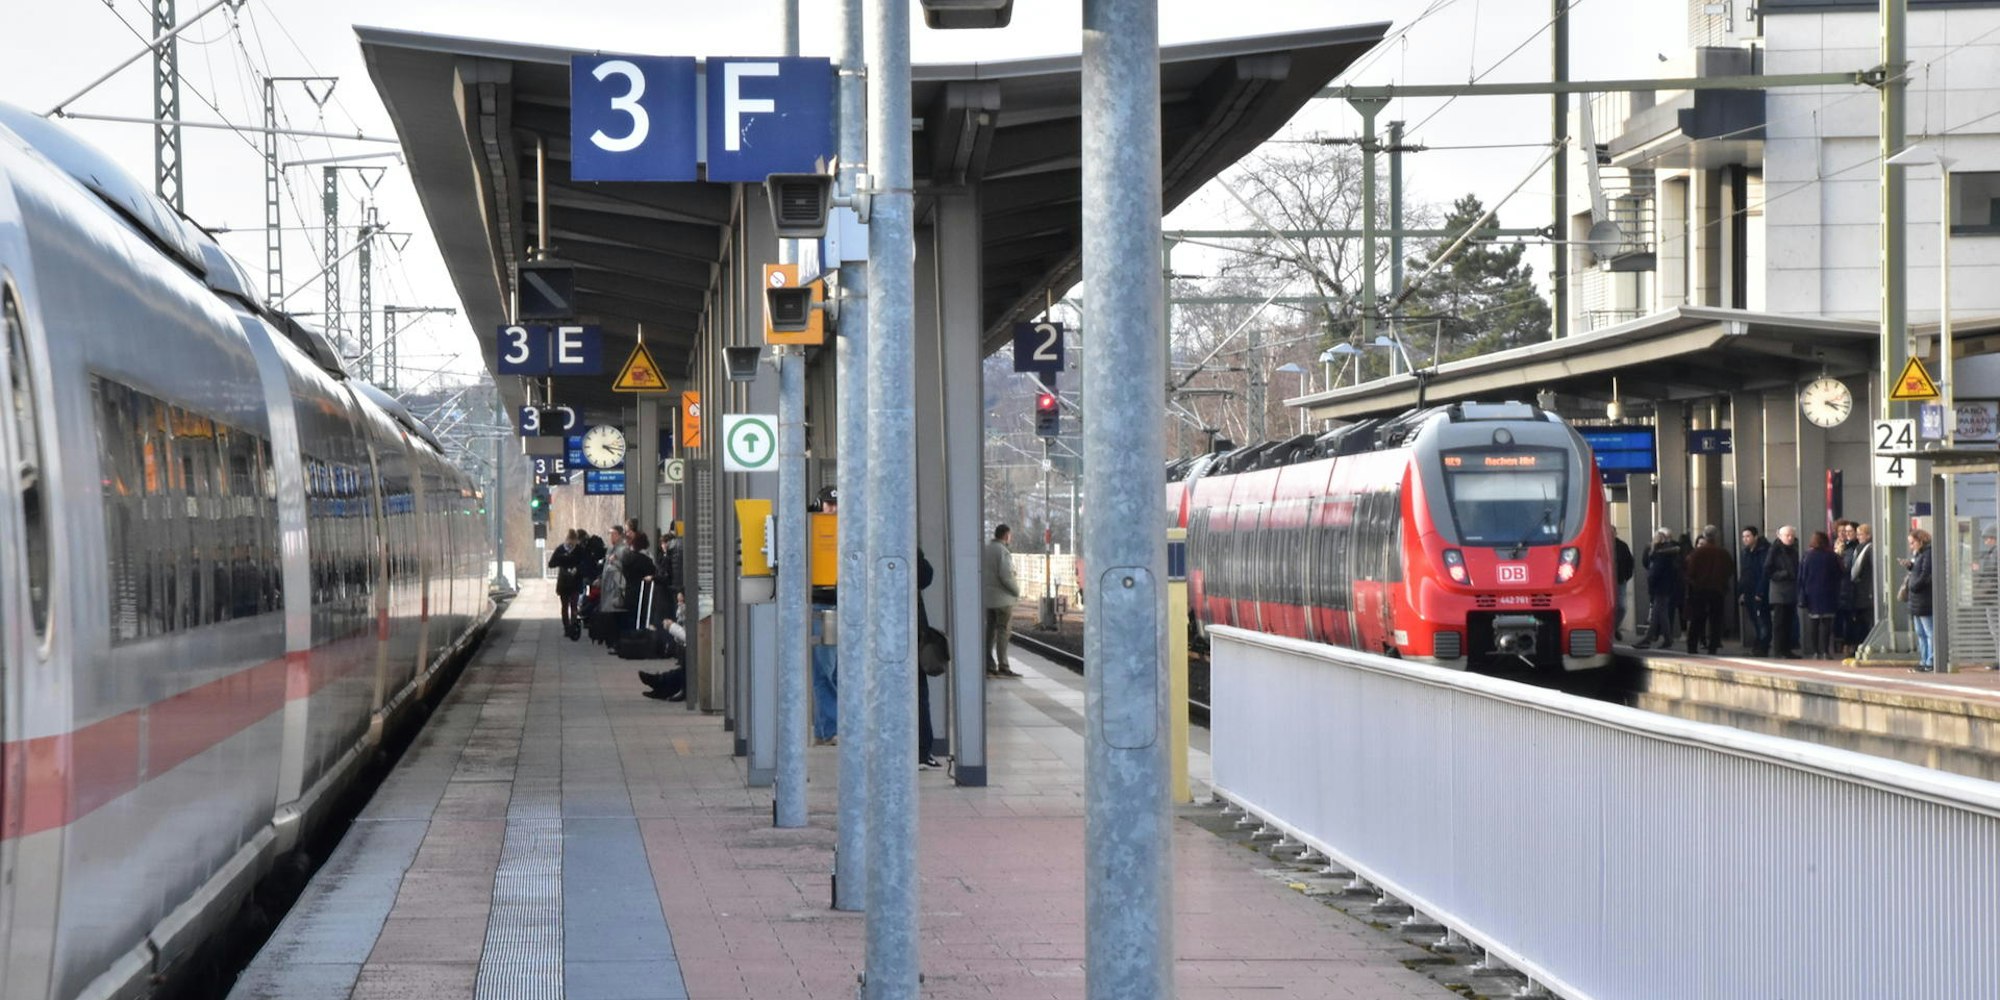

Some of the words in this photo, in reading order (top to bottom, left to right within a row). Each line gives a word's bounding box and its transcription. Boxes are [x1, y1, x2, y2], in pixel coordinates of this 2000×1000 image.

[590, 60, 649, 151] 3
[724, 62, 779, 151] F
[504, 326, 529, 363] 3
[558, 327, 584, 363] E
[1033, 323, 1057, 360] 2
[523, 406, 539, 430] 3
[1876, 423, 1913, 449] 24
[536, 459, 546, 474] 3
[555, 459, 565, 474] E
[1886, 456, 1904, 479] 4
[1500, 566, 1525, 581] DB
